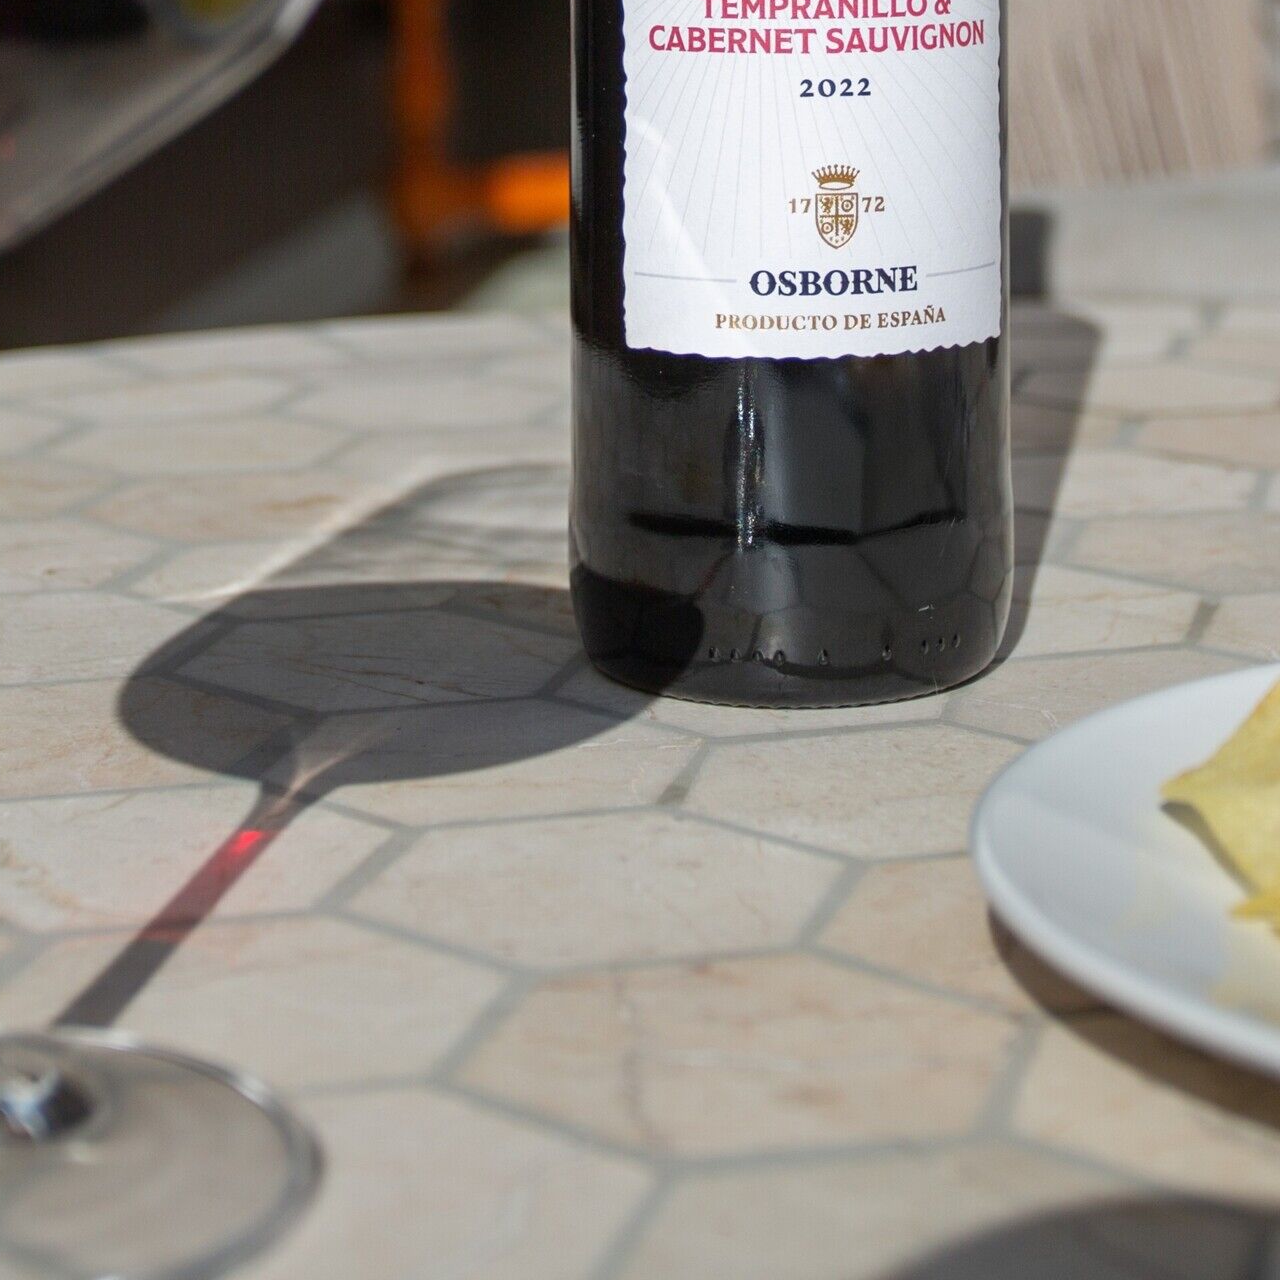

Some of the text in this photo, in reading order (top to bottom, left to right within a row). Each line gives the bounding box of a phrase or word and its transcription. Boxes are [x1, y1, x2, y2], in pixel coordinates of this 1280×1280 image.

[649, 19, 985, 54] CABERNET SAUVIGNON
[799, 77, 872, 98] 2022
[788, 196, 886, 215] 17 72
[749, 265, 918, 297] OSBORNE
[715, 305, 946, 331] PRODUCTO DE ESPAÑA
